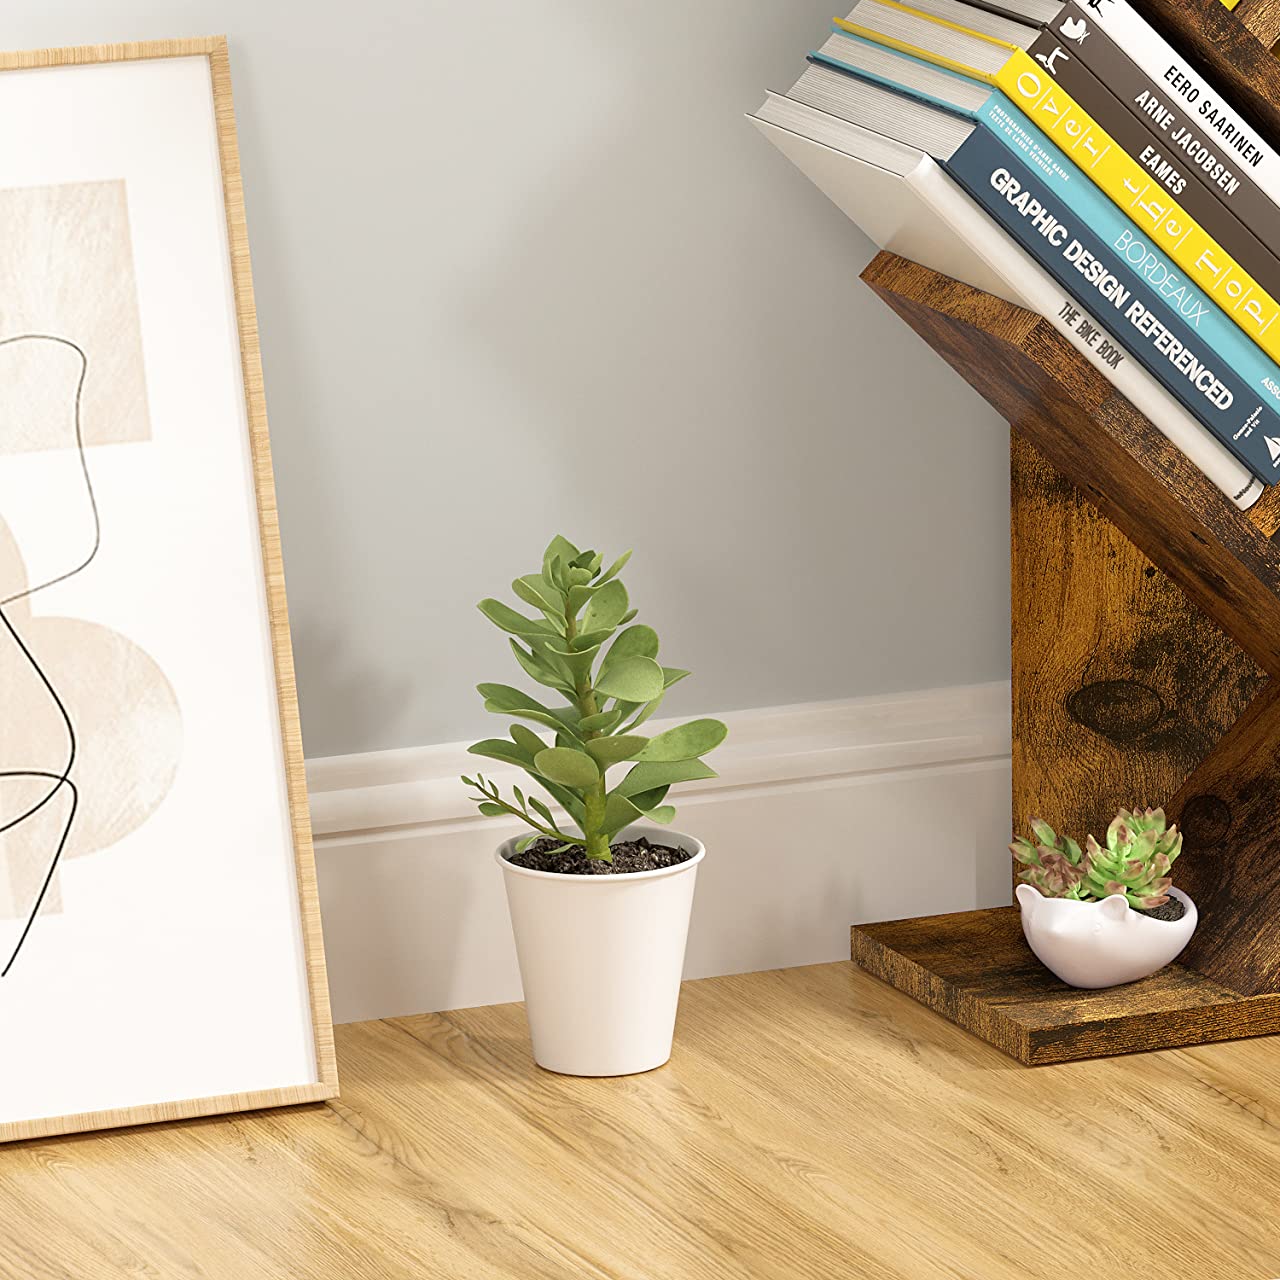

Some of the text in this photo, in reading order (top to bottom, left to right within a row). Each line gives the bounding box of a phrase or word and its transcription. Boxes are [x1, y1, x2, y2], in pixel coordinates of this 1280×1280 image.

[1133, 87, 1242, 197] ARNE JACOBSEN
[1161, 63, 1265, 169] EERO SAARINEN
[1011, 66, 1272, 329] Over the Top
[1137, 144, 1189, 196] EAMES
[986, 163, 1237, 415] GRAPHIC DESIGN REFERENCED
[1111, 227, 1211, 329] BORDEAUX
[1055, 300, 1125, 370] THE BIKE BOOK
